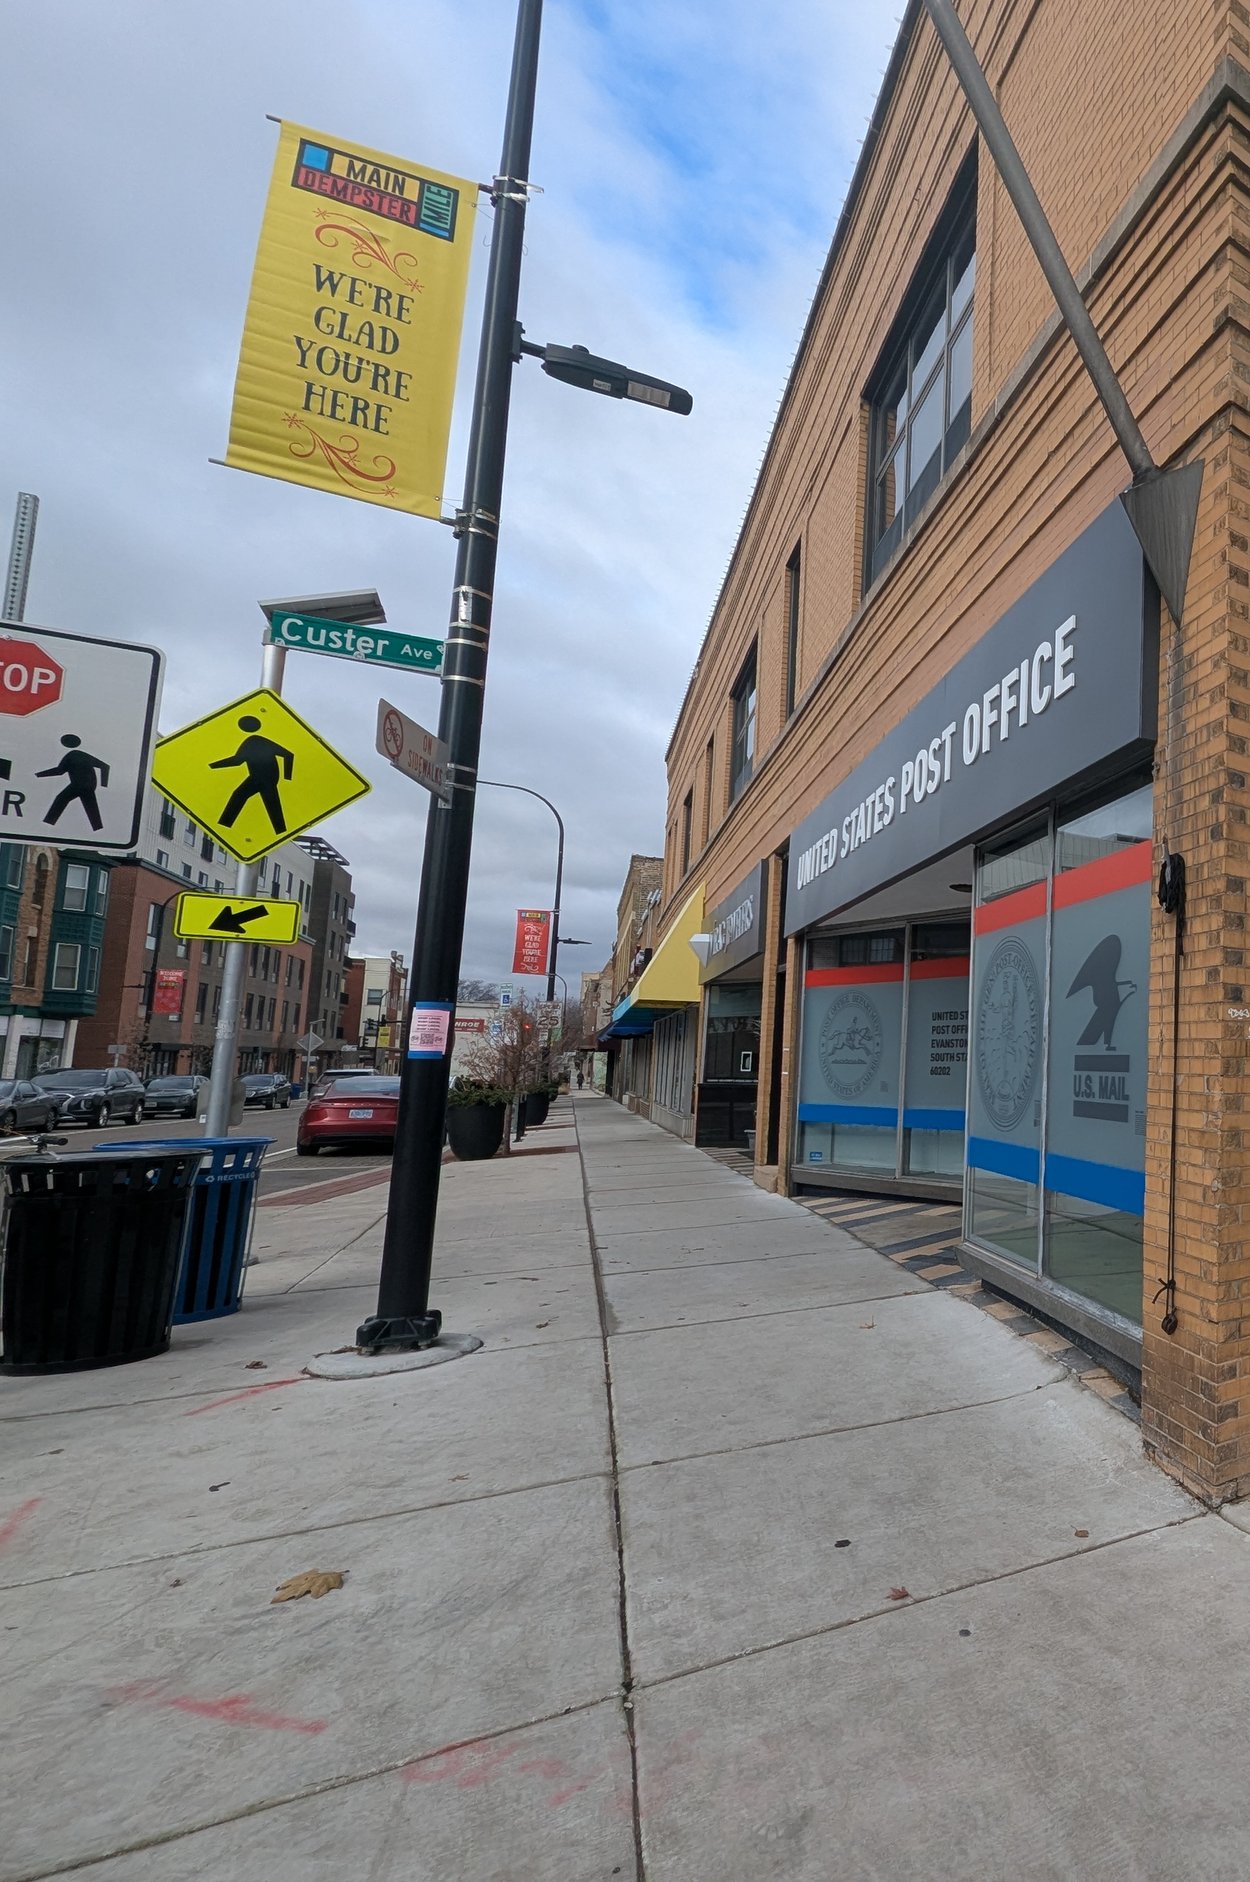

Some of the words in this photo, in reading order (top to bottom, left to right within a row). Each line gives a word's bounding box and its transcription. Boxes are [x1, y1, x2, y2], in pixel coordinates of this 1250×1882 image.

[346, 159, 406, 196] MAIN
[304, 170, 411, 225] DEMPSTER
[423, 185, 451, 227] MILE
[313, 263, 414, 325] WE'RE
[314, 306, 400, 355] GLAD
[293, 335, 413, 402] YOU'RE
[302, 380, 393, 436] HERE
[281, 617, 390, 656] Custer
[401, 644, 433, 660] Ave
[423, 735, 433, 756] ON
[797, 828, 838, 890] UNITED
[841, 776, 896, 859] STATES
[900, 721, 957, 815] POST
[962, 614, 1077, 767] OFFICE
[408, 749, 443, 786] SIDEWALKS
[538, 1016, 559, 1027] 25
[931, 1011, 958, 1021] UNITED
[931, 1025, 950, 1035] POST
[951, 1024, 968, 1034] OFFI
[930, 1053, 954, 1062] SOUTH
[930, 1066, 951, 1076] 60202
[1073, 1074, 1095, 1099] U.S.
[1099, 1075, 1129, 1101] MAIL
